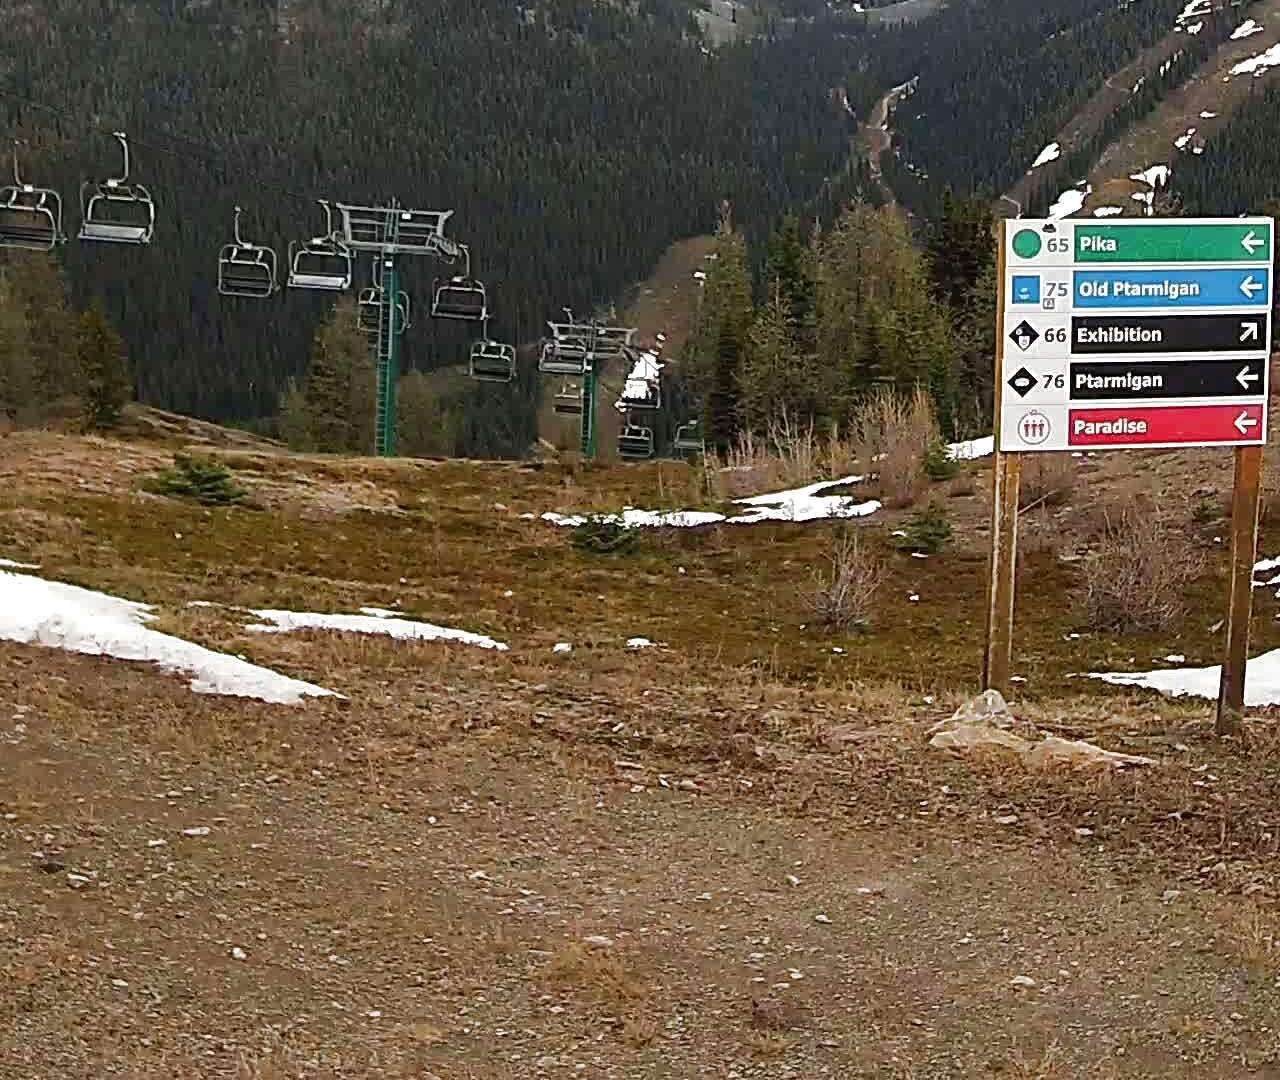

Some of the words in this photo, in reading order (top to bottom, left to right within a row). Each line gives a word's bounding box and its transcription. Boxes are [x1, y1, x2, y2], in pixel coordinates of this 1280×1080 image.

[1047, 237, 1069, 253] 65
[1080, 235, 1117, 252] Pika
[1046, 282, 1068, 297] 75
[1079, 282, 1109, 297] Old
[1113, 281, 1200, 299] Ptarmigan
[1044, 328, 1067, 343] 66
[1077, 327, 1162, 343] Exhibition
[1042, 374, 1065, 389] 76
[1075, 372, 1163, 391] Ptarmigan
[1073, 418, 1147, 435] Paradise
